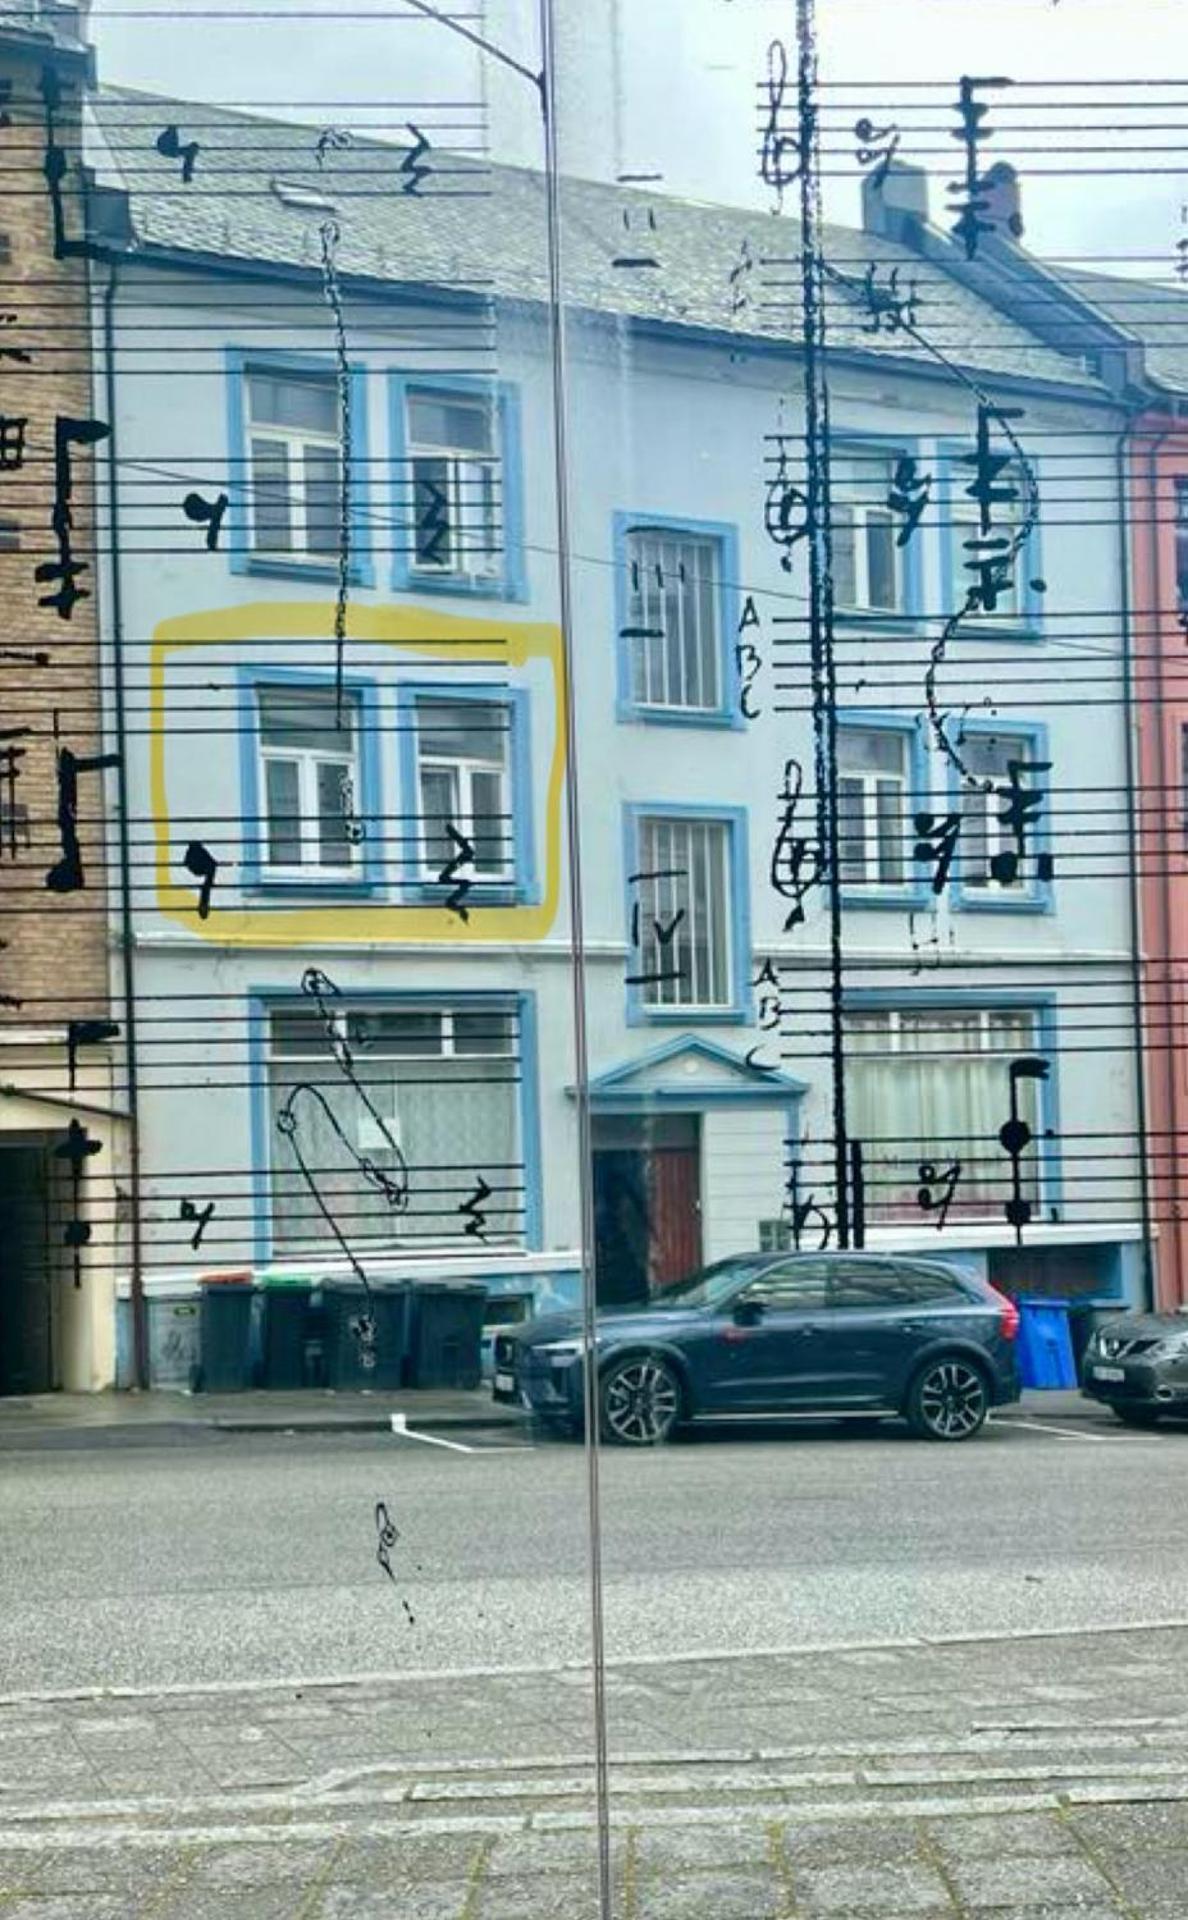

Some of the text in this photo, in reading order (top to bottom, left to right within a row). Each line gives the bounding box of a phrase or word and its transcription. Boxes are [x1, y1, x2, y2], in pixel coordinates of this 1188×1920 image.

[738, 595, 760, 633] A
[735, 644, 762, 682] B
[740, 684, 760, 719] C
[750, 957, 779, 987] A
[759, 996, 781, 1030] B
